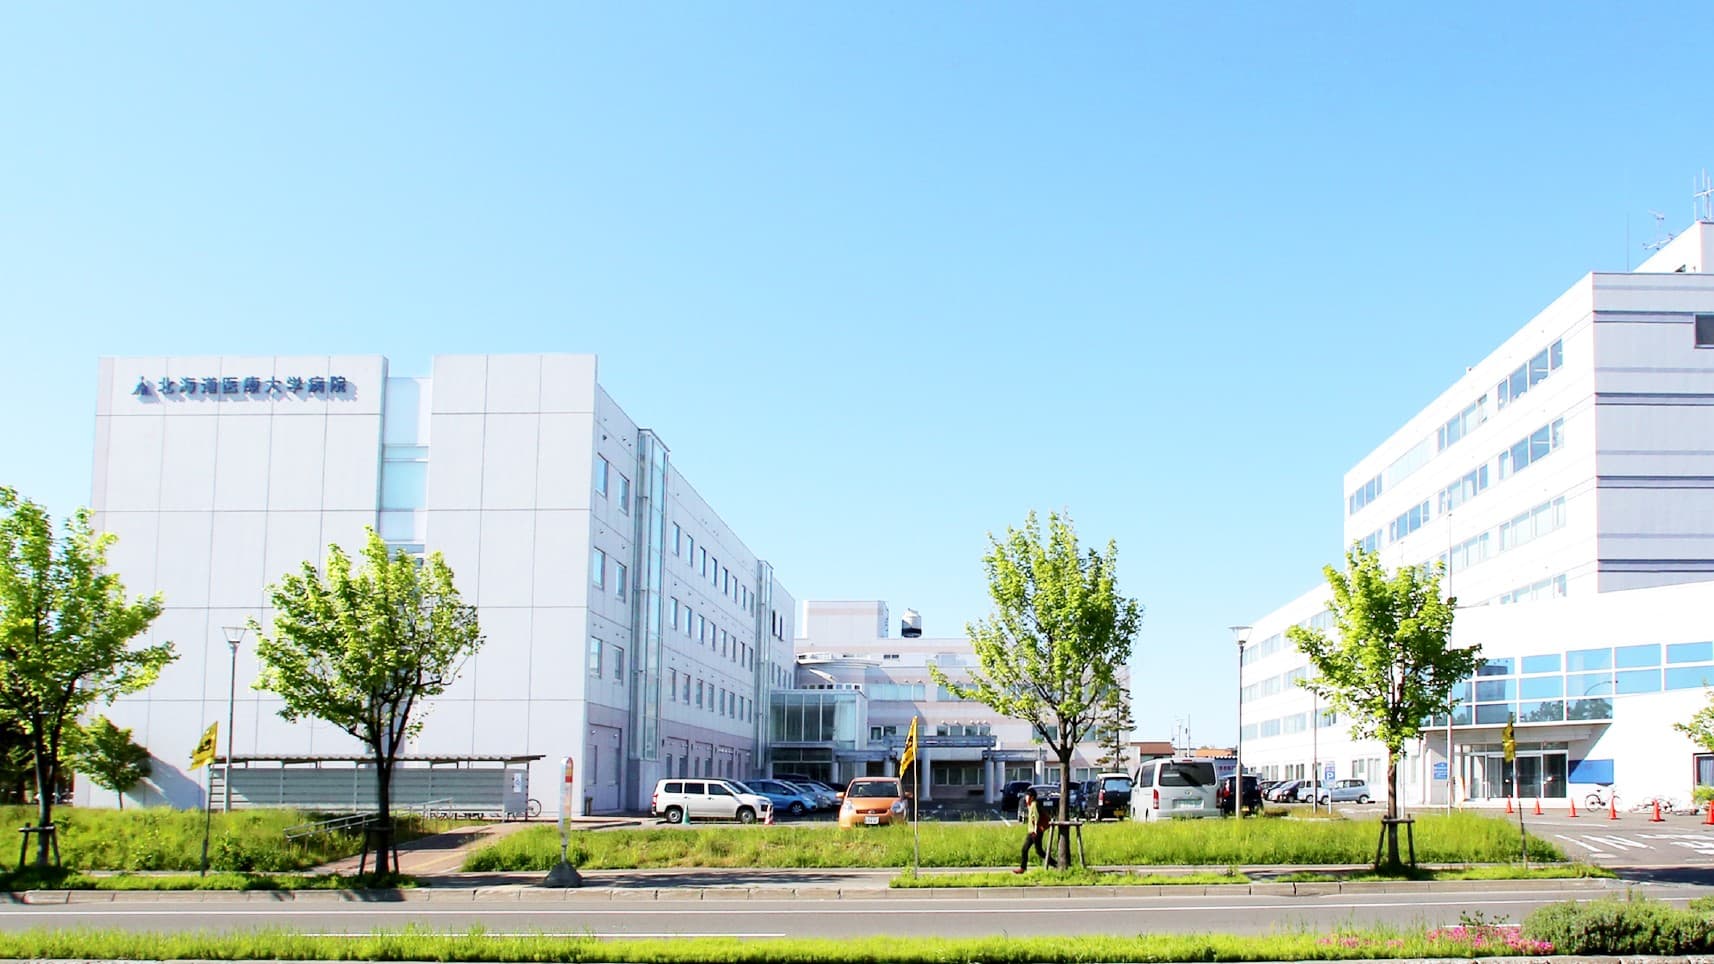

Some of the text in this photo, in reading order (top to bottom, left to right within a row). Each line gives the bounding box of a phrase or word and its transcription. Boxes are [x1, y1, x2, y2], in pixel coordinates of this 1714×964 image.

[158, 376, 347, 394] 北海道医療大学病院
[1326, 771, 1334, 781] P
